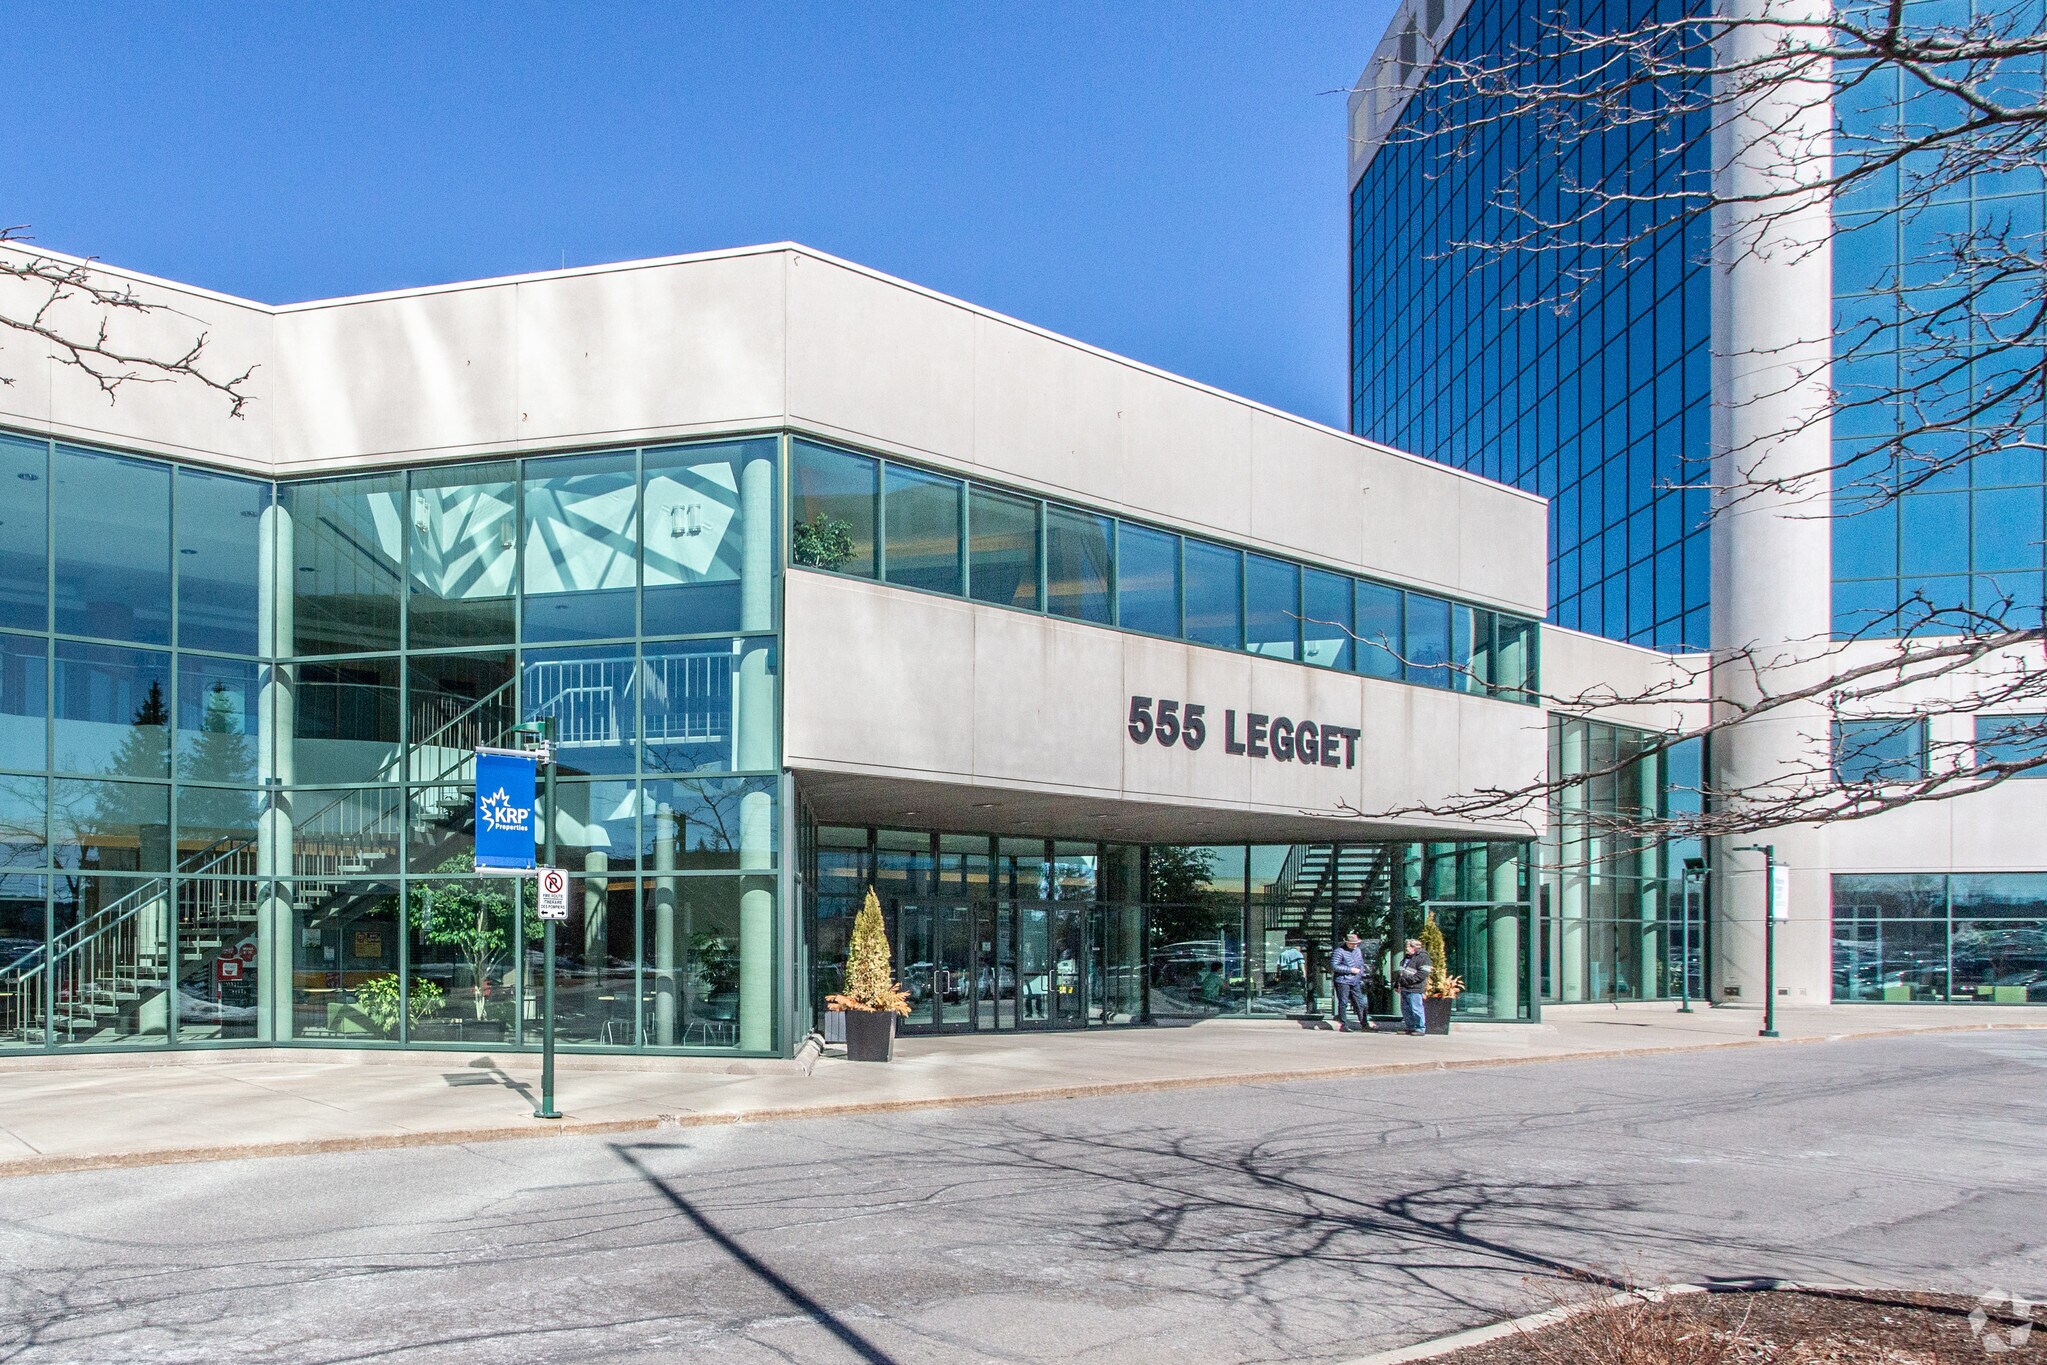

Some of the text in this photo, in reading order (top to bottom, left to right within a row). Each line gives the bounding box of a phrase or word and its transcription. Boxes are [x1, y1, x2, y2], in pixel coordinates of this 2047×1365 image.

[1128, 695, 1362, 770] 555 LEGGET
[495, 806, 529, 824] KRP
[495, 823, 529, 832] Properties
